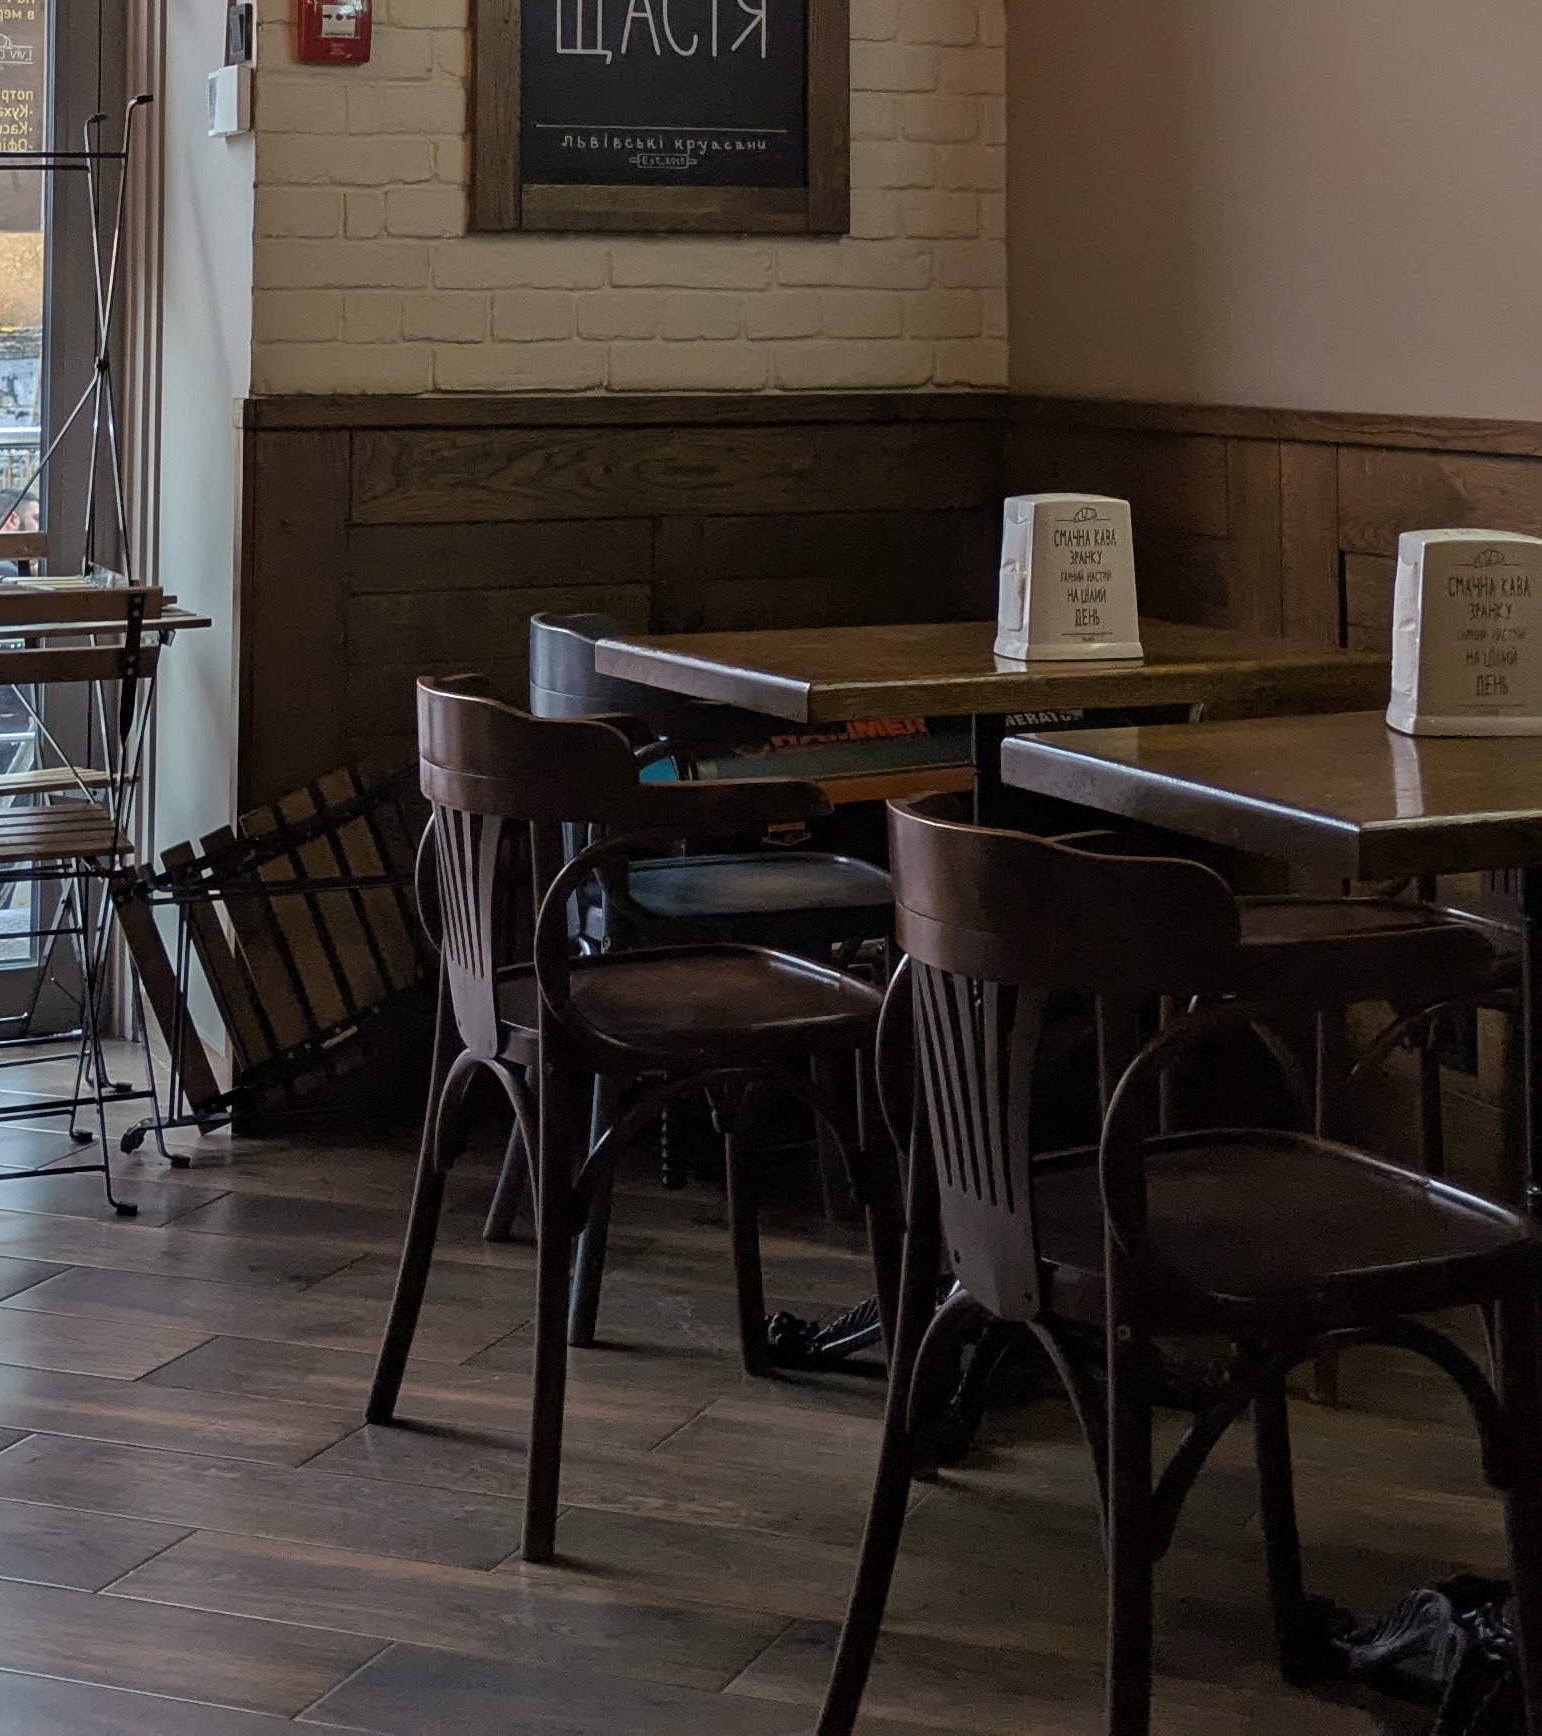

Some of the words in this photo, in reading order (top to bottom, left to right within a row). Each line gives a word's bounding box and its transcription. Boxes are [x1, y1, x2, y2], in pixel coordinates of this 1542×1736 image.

[1053, 528, 1091, 548] СМАЧНА
[1094, 528, 1117, 547] КАВА
[1069, 550, 1102, 565] ЗРАНКУ
[1067, 589, 1079, 603] НА
[1447, 575, 1497, 598] СМАЧНА
[1501, 575, 1531, 598] КАВА
[1075, 608, 1101, 628] ДЕНЬ
[1476, 674, 1508, 697] ДЕНЬ
